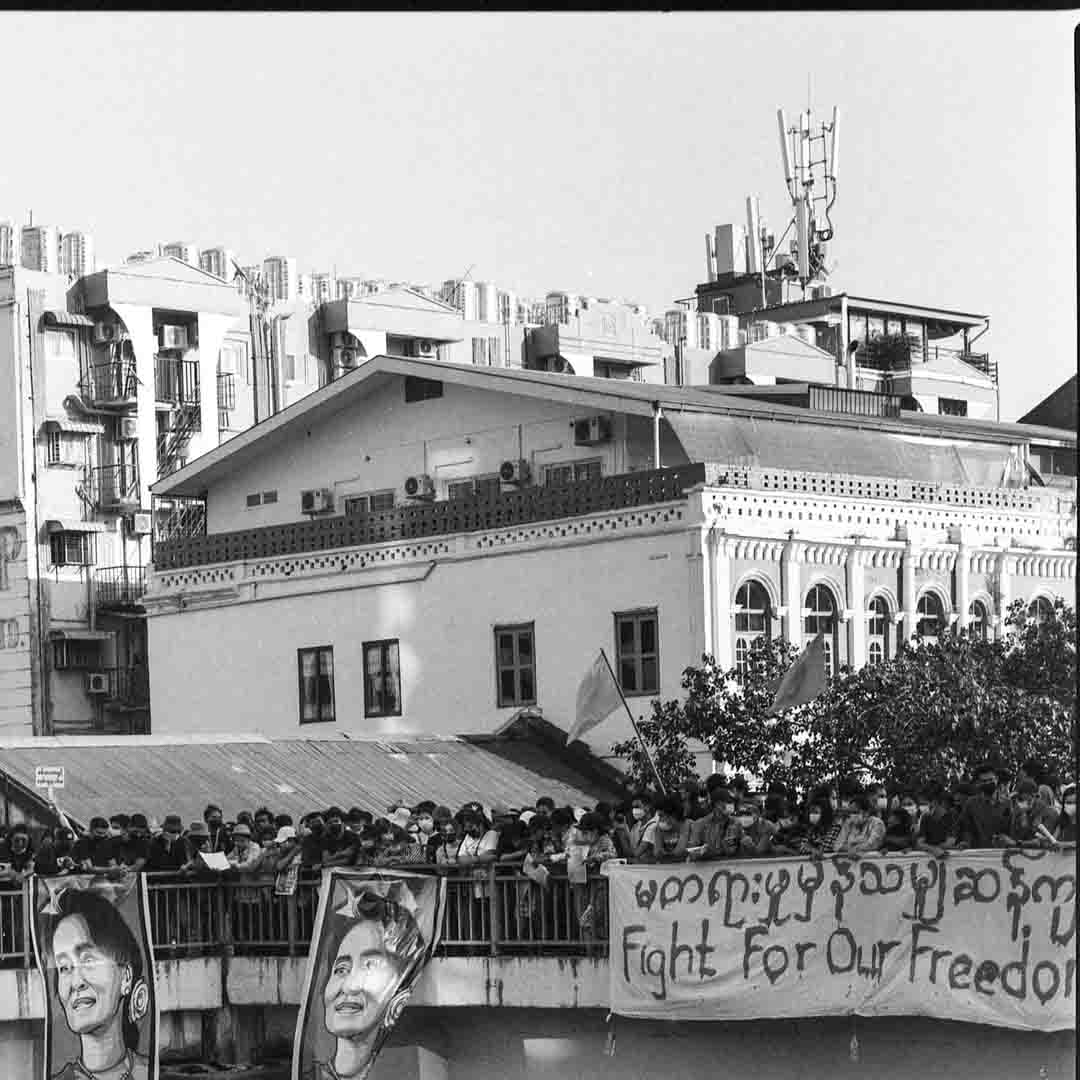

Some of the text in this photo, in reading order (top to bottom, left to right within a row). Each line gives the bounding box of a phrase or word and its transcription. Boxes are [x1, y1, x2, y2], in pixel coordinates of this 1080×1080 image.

[622, 919, 717, 1000] Fight
[743, 925, 817, 985] For
[826, 927, 902, 984] Our
